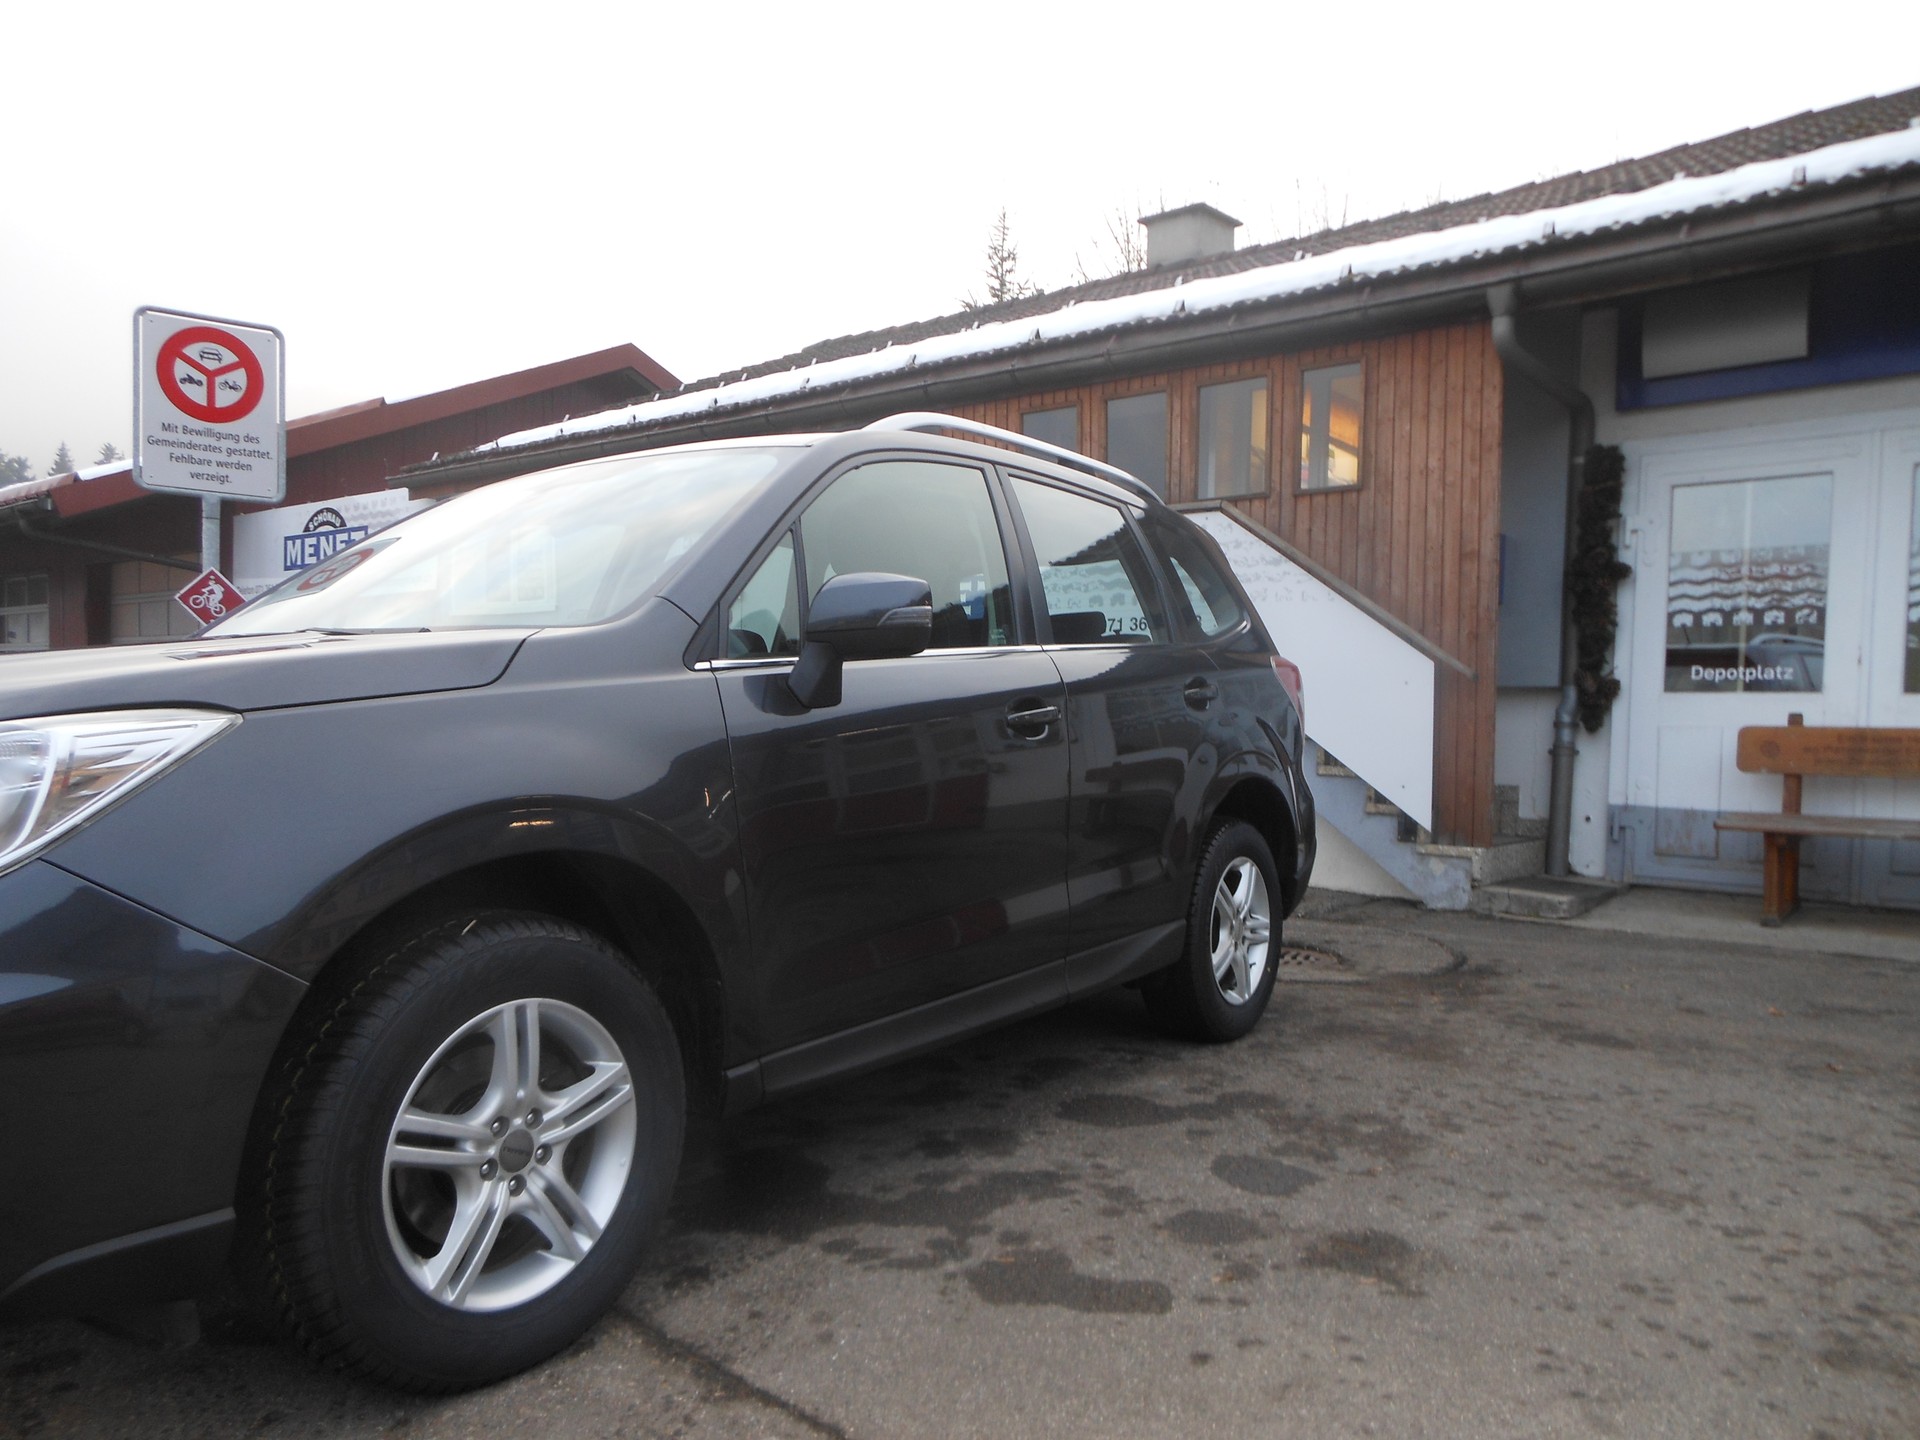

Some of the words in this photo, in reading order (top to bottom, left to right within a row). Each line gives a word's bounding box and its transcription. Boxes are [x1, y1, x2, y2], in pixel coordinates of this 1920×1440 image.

[161, 422, 179, 434] Mit
[182, 425, 240, 444] Bewilligung
[243, 433, 260, 445] des
[147, 435, 223, 454] Gemeinderates
[226, 446, 273, 461] gestattet.
[169, 452, 213, 467] Fehlbare
[216, 460, 252, 472] werden
[190, 471, 233, 485] verzeigt.
[1129, 617, 1147, 631] 36
[1690, 665, 1794, 683] Depotplatz
